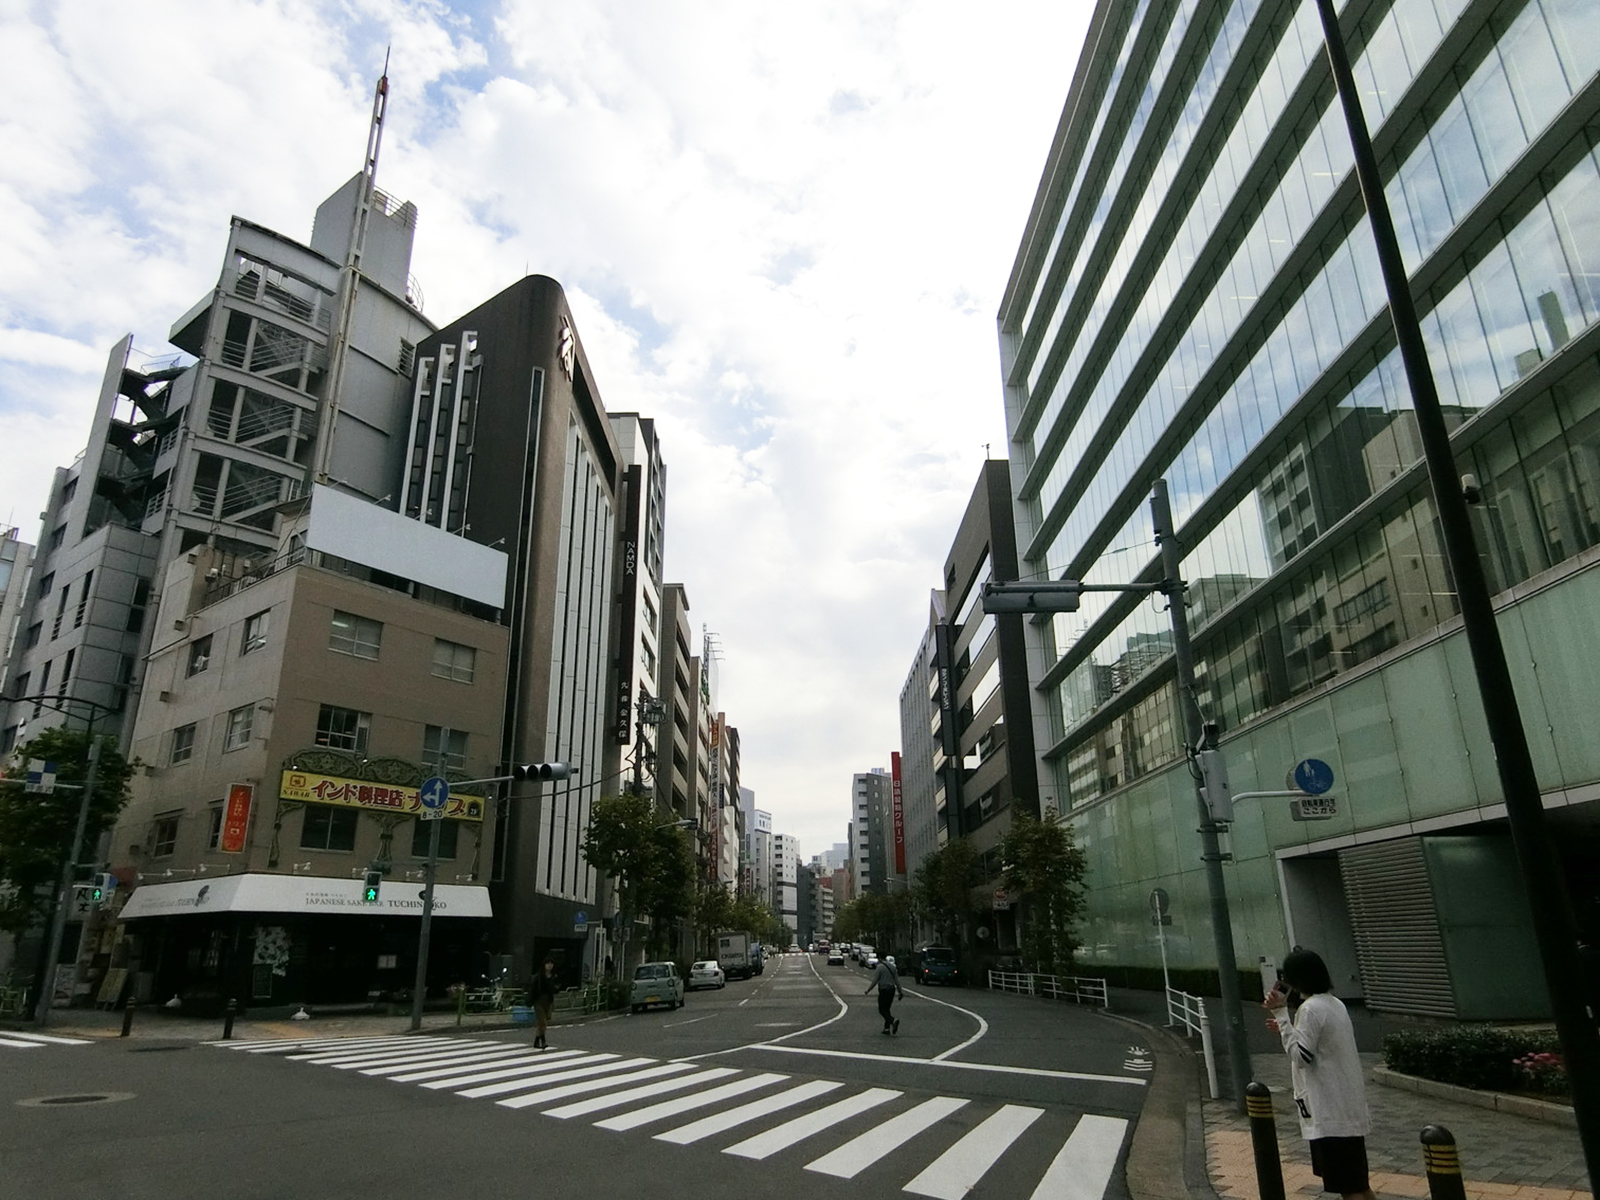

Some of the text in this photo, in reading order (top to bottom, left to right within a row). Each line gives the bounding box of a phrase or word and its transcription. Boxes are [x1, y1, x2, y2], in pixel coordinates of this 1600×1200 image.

[311, 780, 404, 808] インド料理店
[422, 810, 442, 819] 8-20
[1303, 806, 1336, 814] ここから
[305, 898, 345, 906] JAPANESE
[387, 900, 447, 909] TUCHINKO
